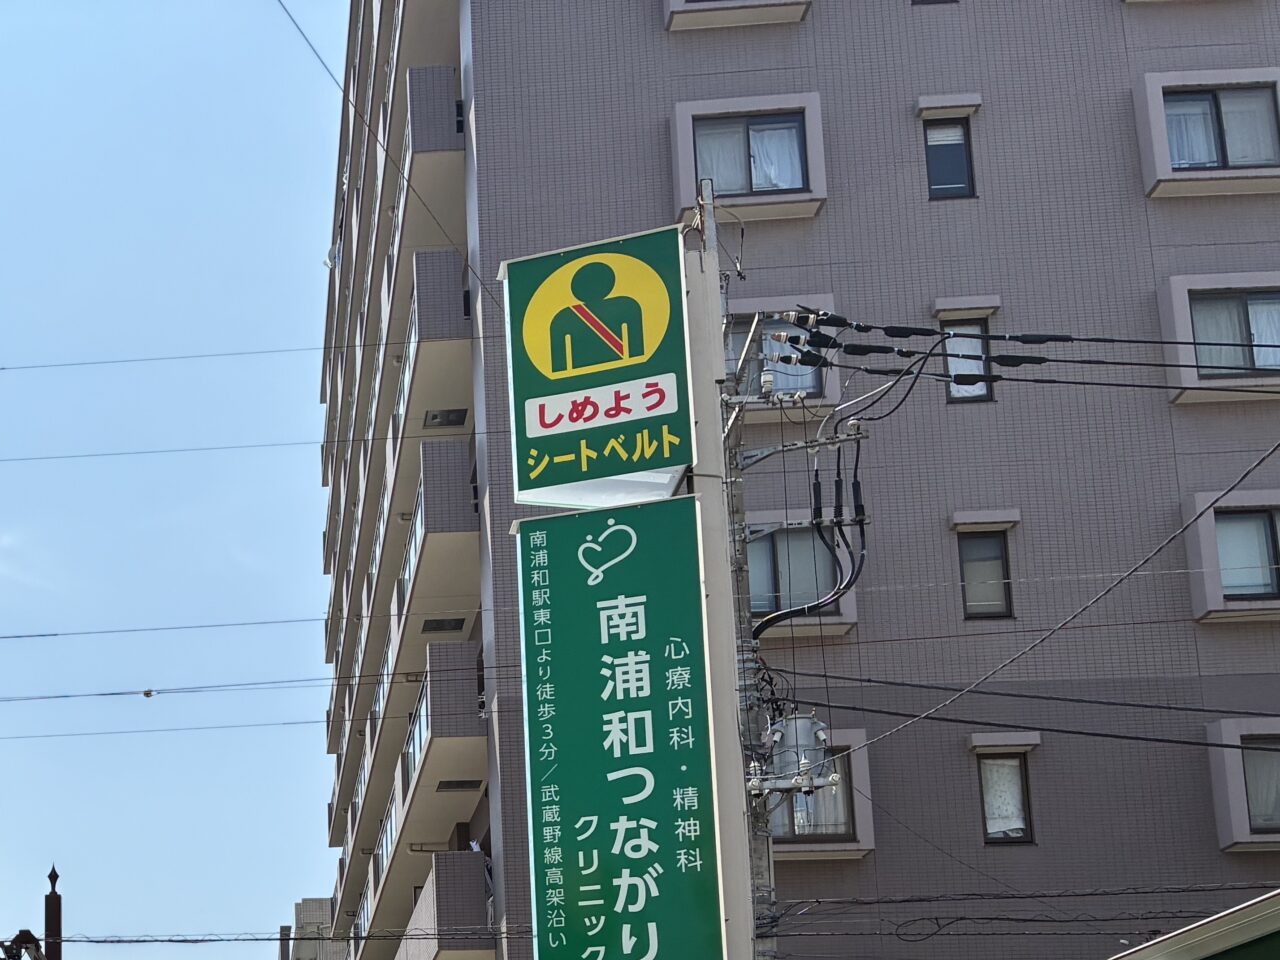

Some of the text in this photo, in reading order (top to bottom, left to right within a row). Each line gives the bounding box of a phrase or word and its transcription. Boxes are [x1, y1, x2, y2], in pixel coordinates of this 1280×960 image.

[537, 381, 667, 430] しめよう
[526, 424, 681, 480] シートベルト
[664, 637, 703, 873] 心療内科・精神科
